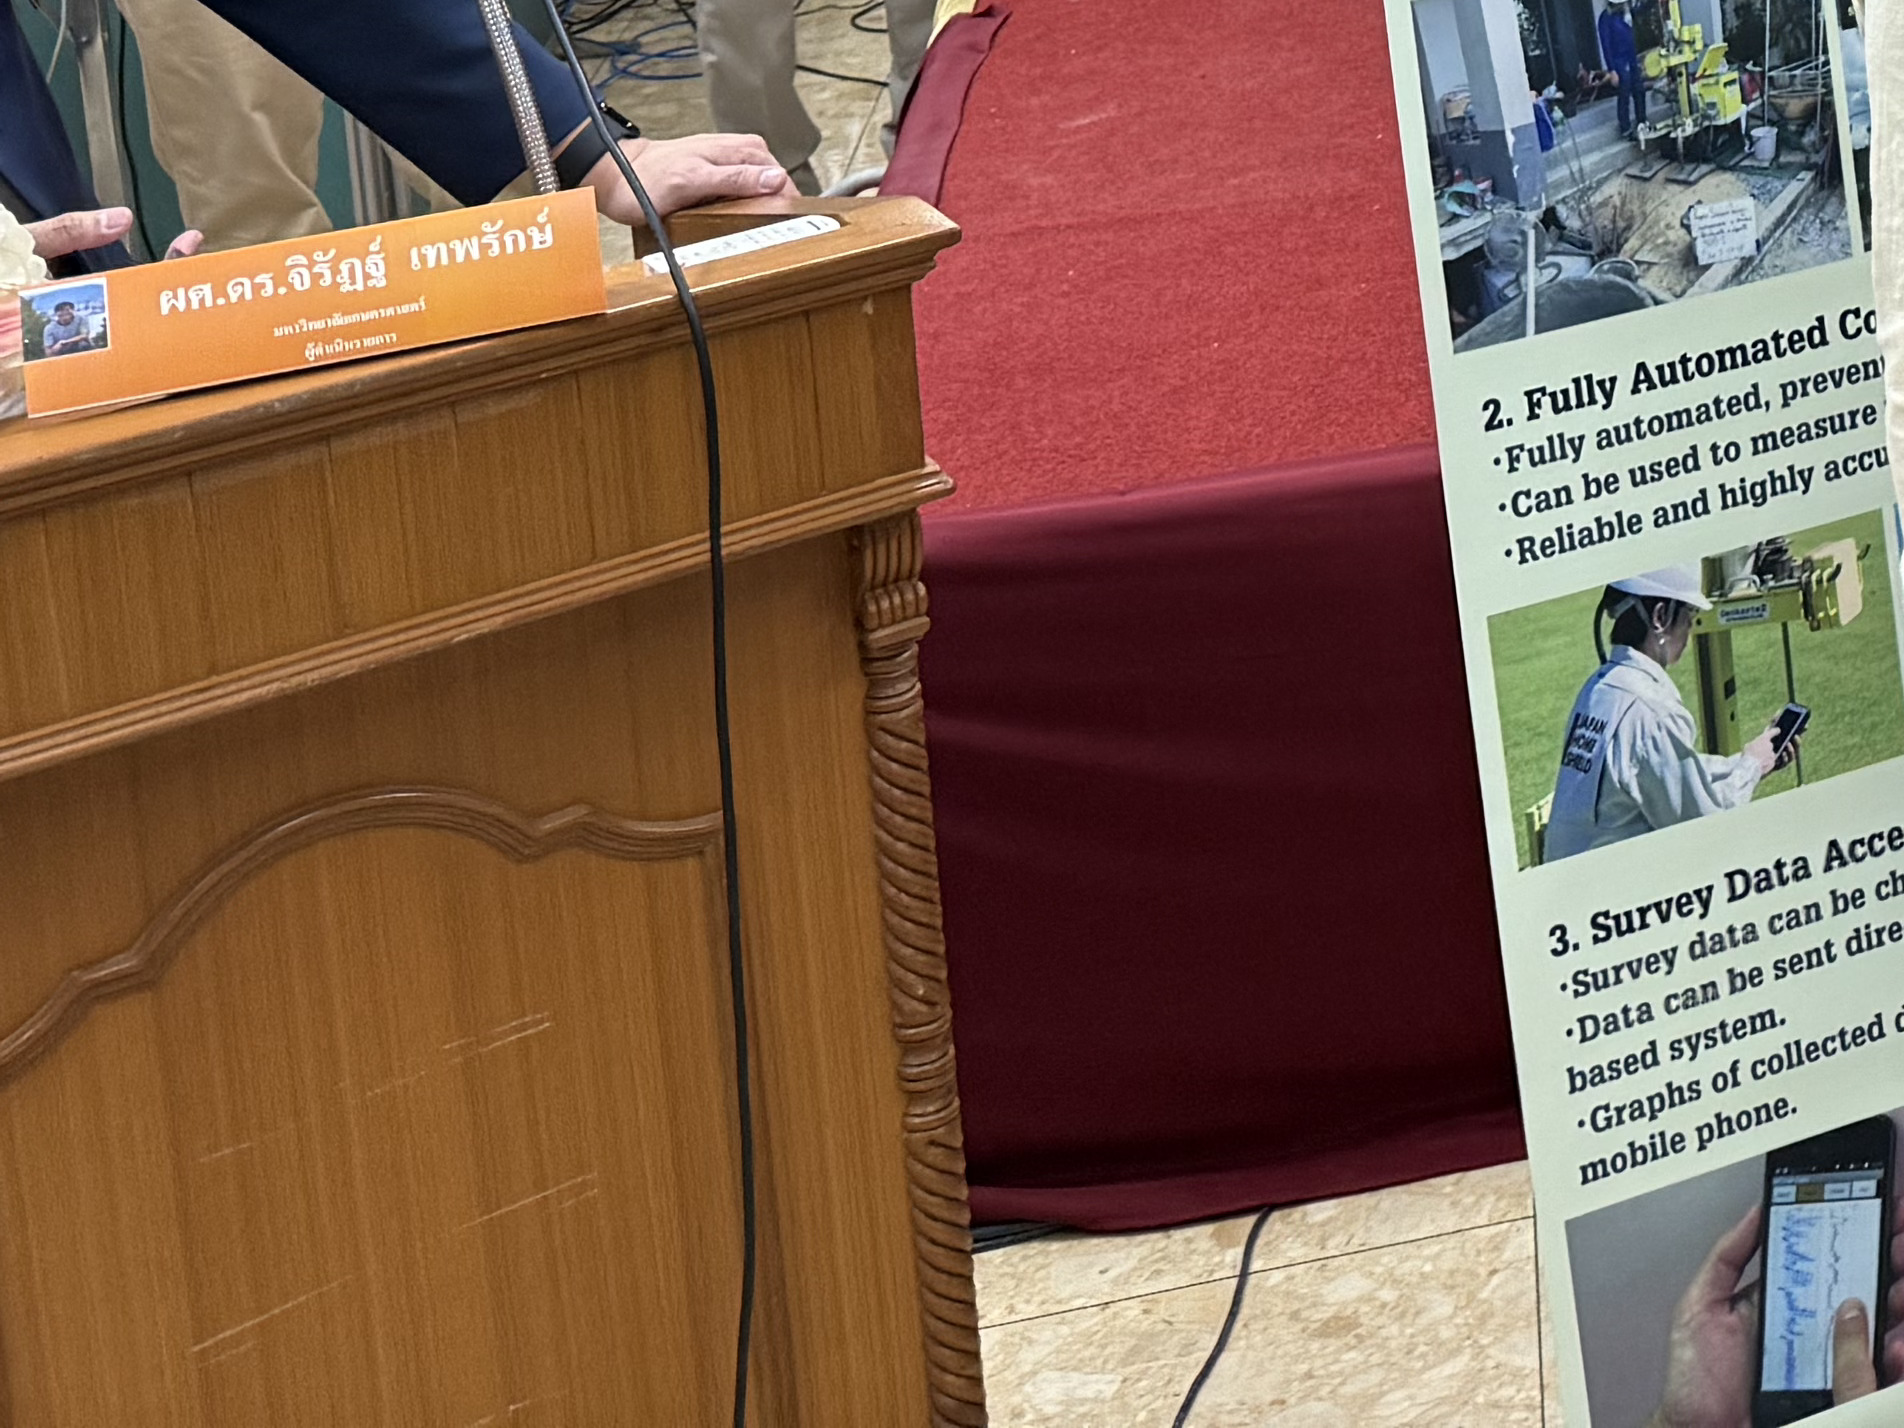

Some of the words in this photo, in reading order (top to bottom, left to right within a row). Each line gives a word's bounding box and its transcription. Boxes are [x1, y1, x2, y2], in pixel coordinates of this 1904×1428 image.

[409, 206, 555, 272] เทพรักษ์
[1481, 398, 1514, 433] 2.
[1523, 373, 1618, 422] Fully
[1630, 314, 1830, 396] Automated
[1504, 432, 1586, 474] Fully
[1596, 382, 1771, 451] automated,
[1511, 484, 1575, 518] Can
[1581, 472, 1620, 501] be
[1628, 443, 1702, 488] used
[1709, 441, 1741, 467] to
[1750, 404, 1877, 457] measure
[1515, 510, 1643, 566] Reliable
[1652, 487, 1711, 529] and
[1718, 464, 1815, 511] highly
[1548, 923, 1580, 957] 3.
[1590, 884, 1715, 946] Survey
[1723, 856, 1813, 904] Data
[1571, 945, 1679, 999] Survey
[1688, 922, 1760, 962] data
[1768, 901, 1824, 936] can
[1829, 887, 1866, 917] be
[1576, 1001, 1655, 1044] Data
[1664, 980, 1720, 1016] can
[1726, 966, 1764, 996] be
[1772, 938, 1838, 981] sent
[1566, 1039, 1661, 1095] based
[1669, 1008, 1786, 1062] system.
[1590, 1079, 1702, 1133] Graphs
[1711, 1059, 1742, 1094] of
[1750, 1012, 1887, 1081] collected
[1579, 1130, 1686, 1186] mobile
[1695, 1097, 1798, 1153] phone.
